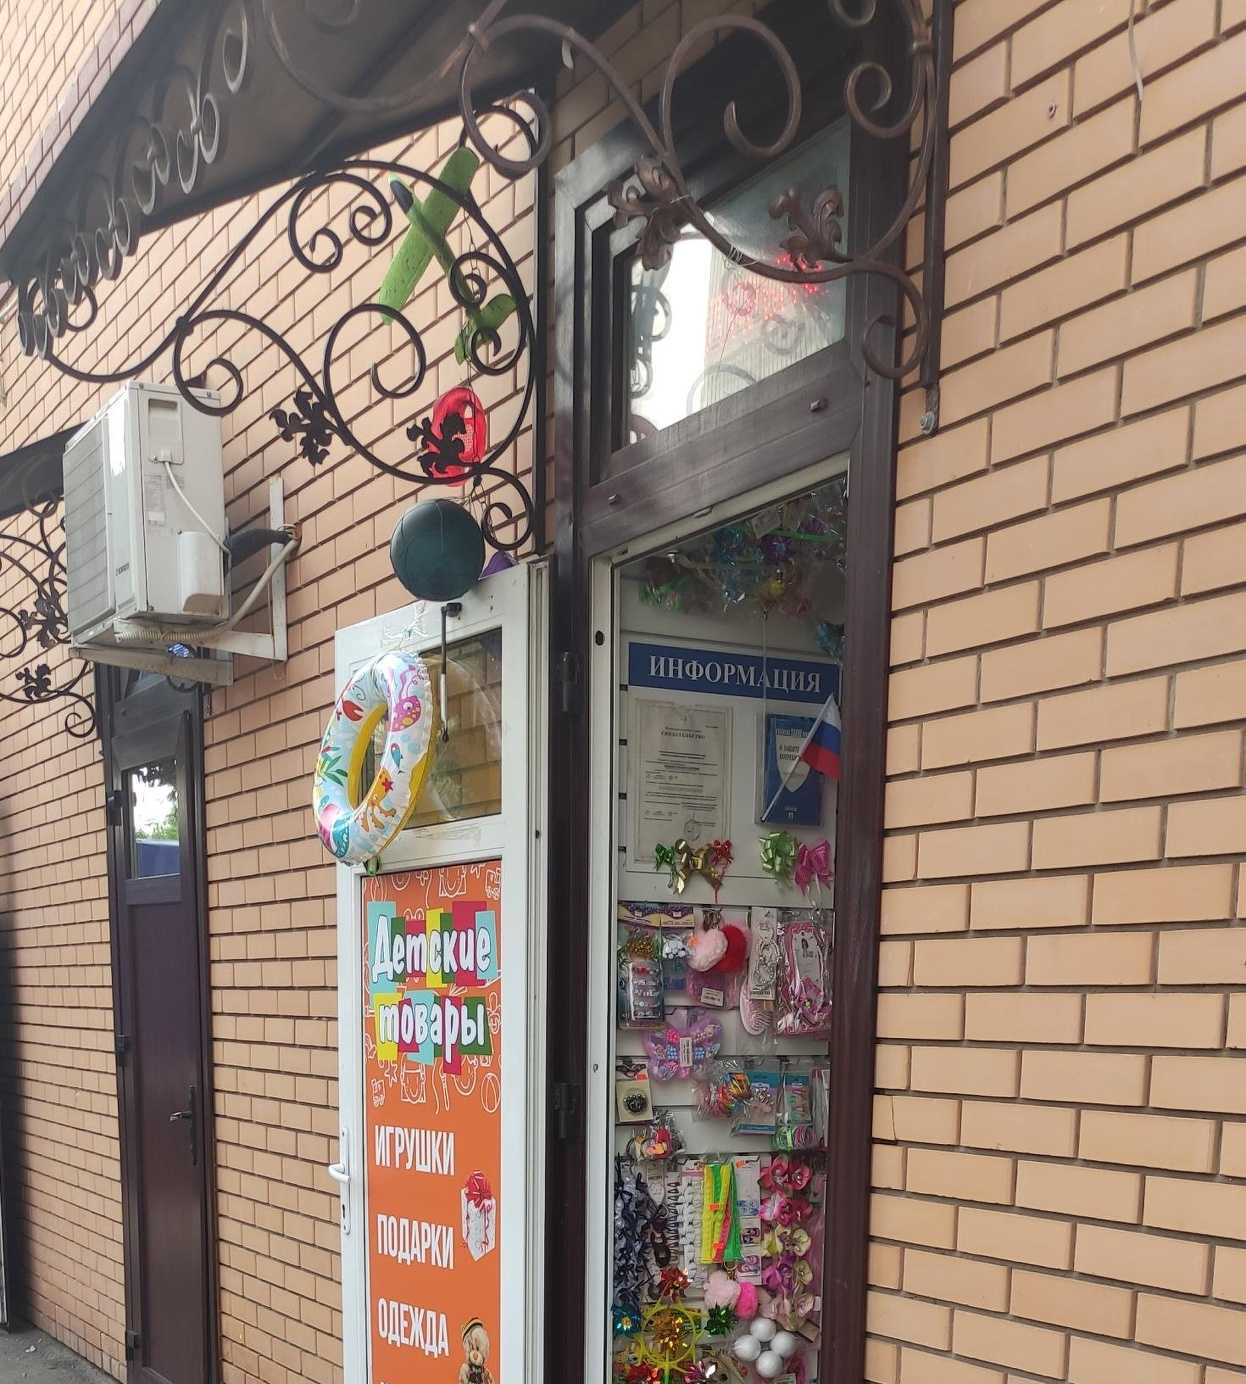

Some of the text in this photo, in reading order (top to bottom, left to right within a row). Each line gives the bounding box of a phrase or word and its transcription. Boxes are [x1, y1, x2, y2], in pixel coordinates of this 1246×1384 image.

[649, 655, 821, 693] ИНФОРМАЦИЯ
[372, 915, 491, 983] Детские
[379, 997, 485, 1064] товары
[375, 1125, 455, 1176] ИГРУШКИ
[377, 1214, 454, 1269] ПОДАРКИ
[378, 1298, 450, 1358] ОДЕЖДА
